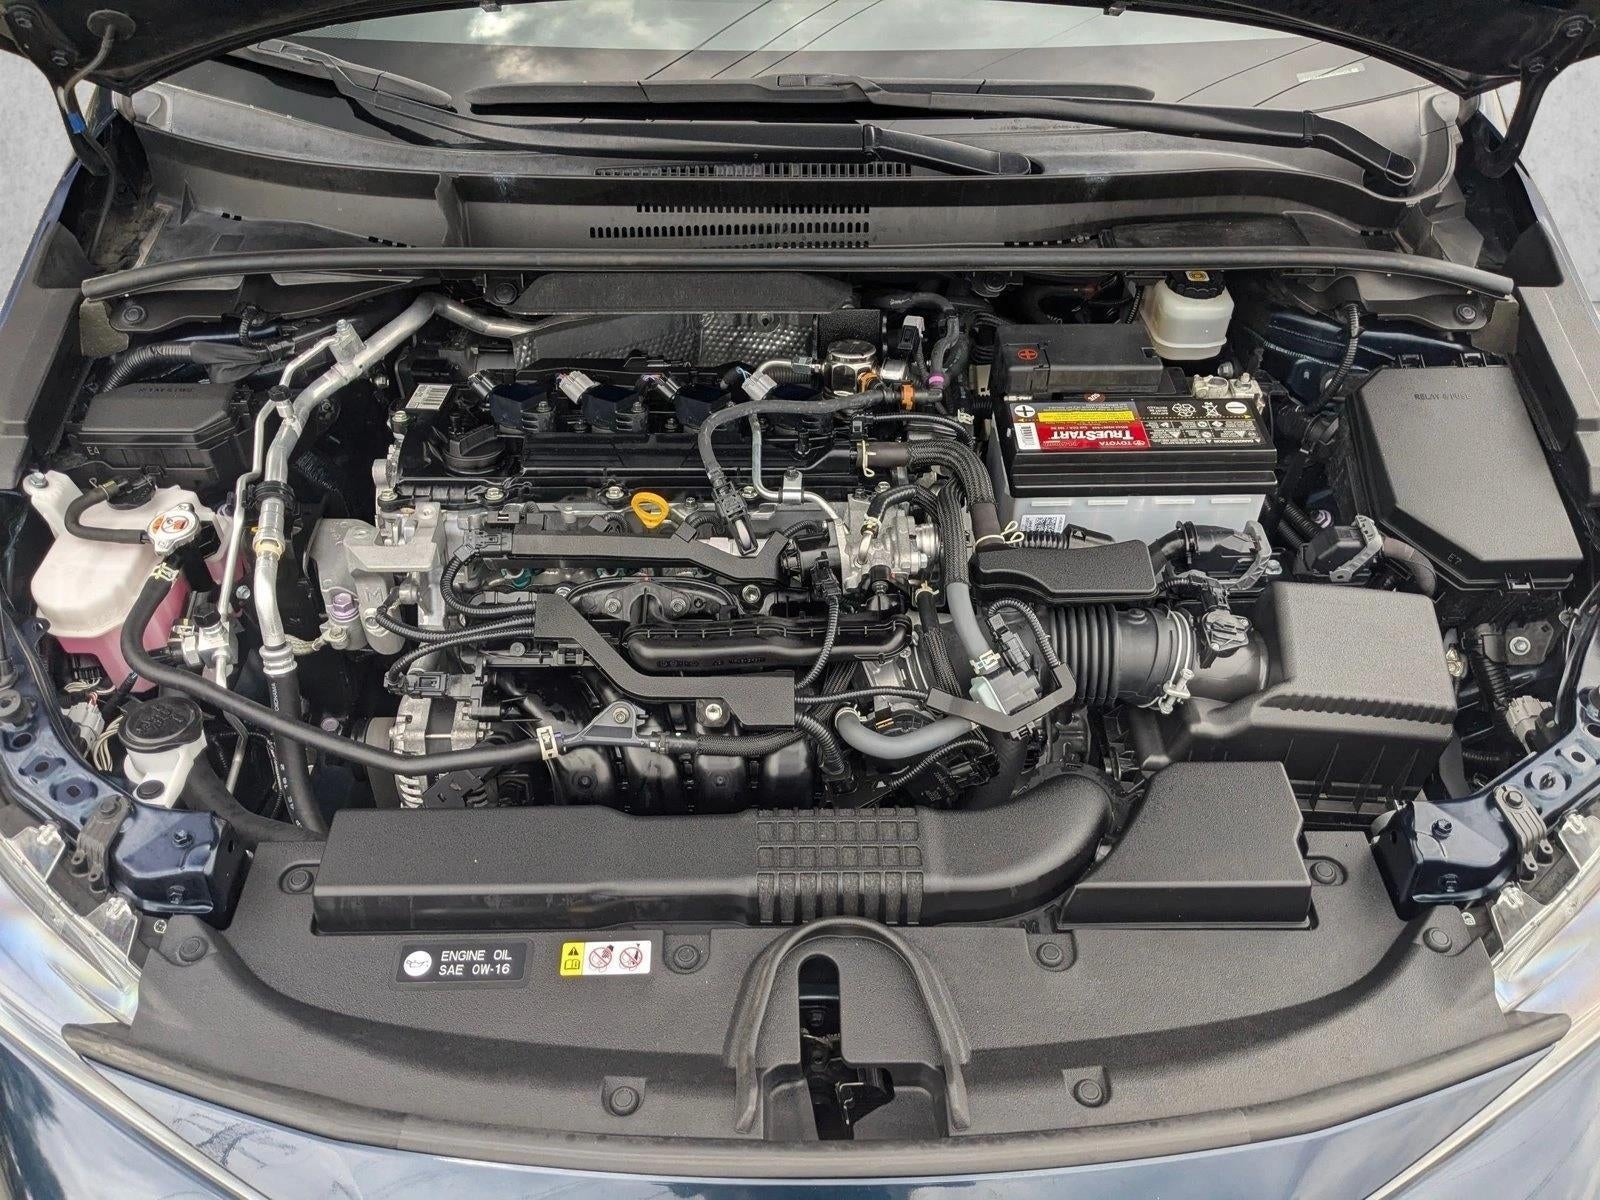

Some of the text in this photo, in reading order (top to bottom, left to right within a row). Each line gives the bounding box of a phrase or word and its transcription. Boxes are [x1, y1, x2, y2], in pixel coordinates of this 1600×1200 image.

[441, 949, 512, 962] ENGINE OIL
[438, 963, 511, 976] SAE 0W-16
